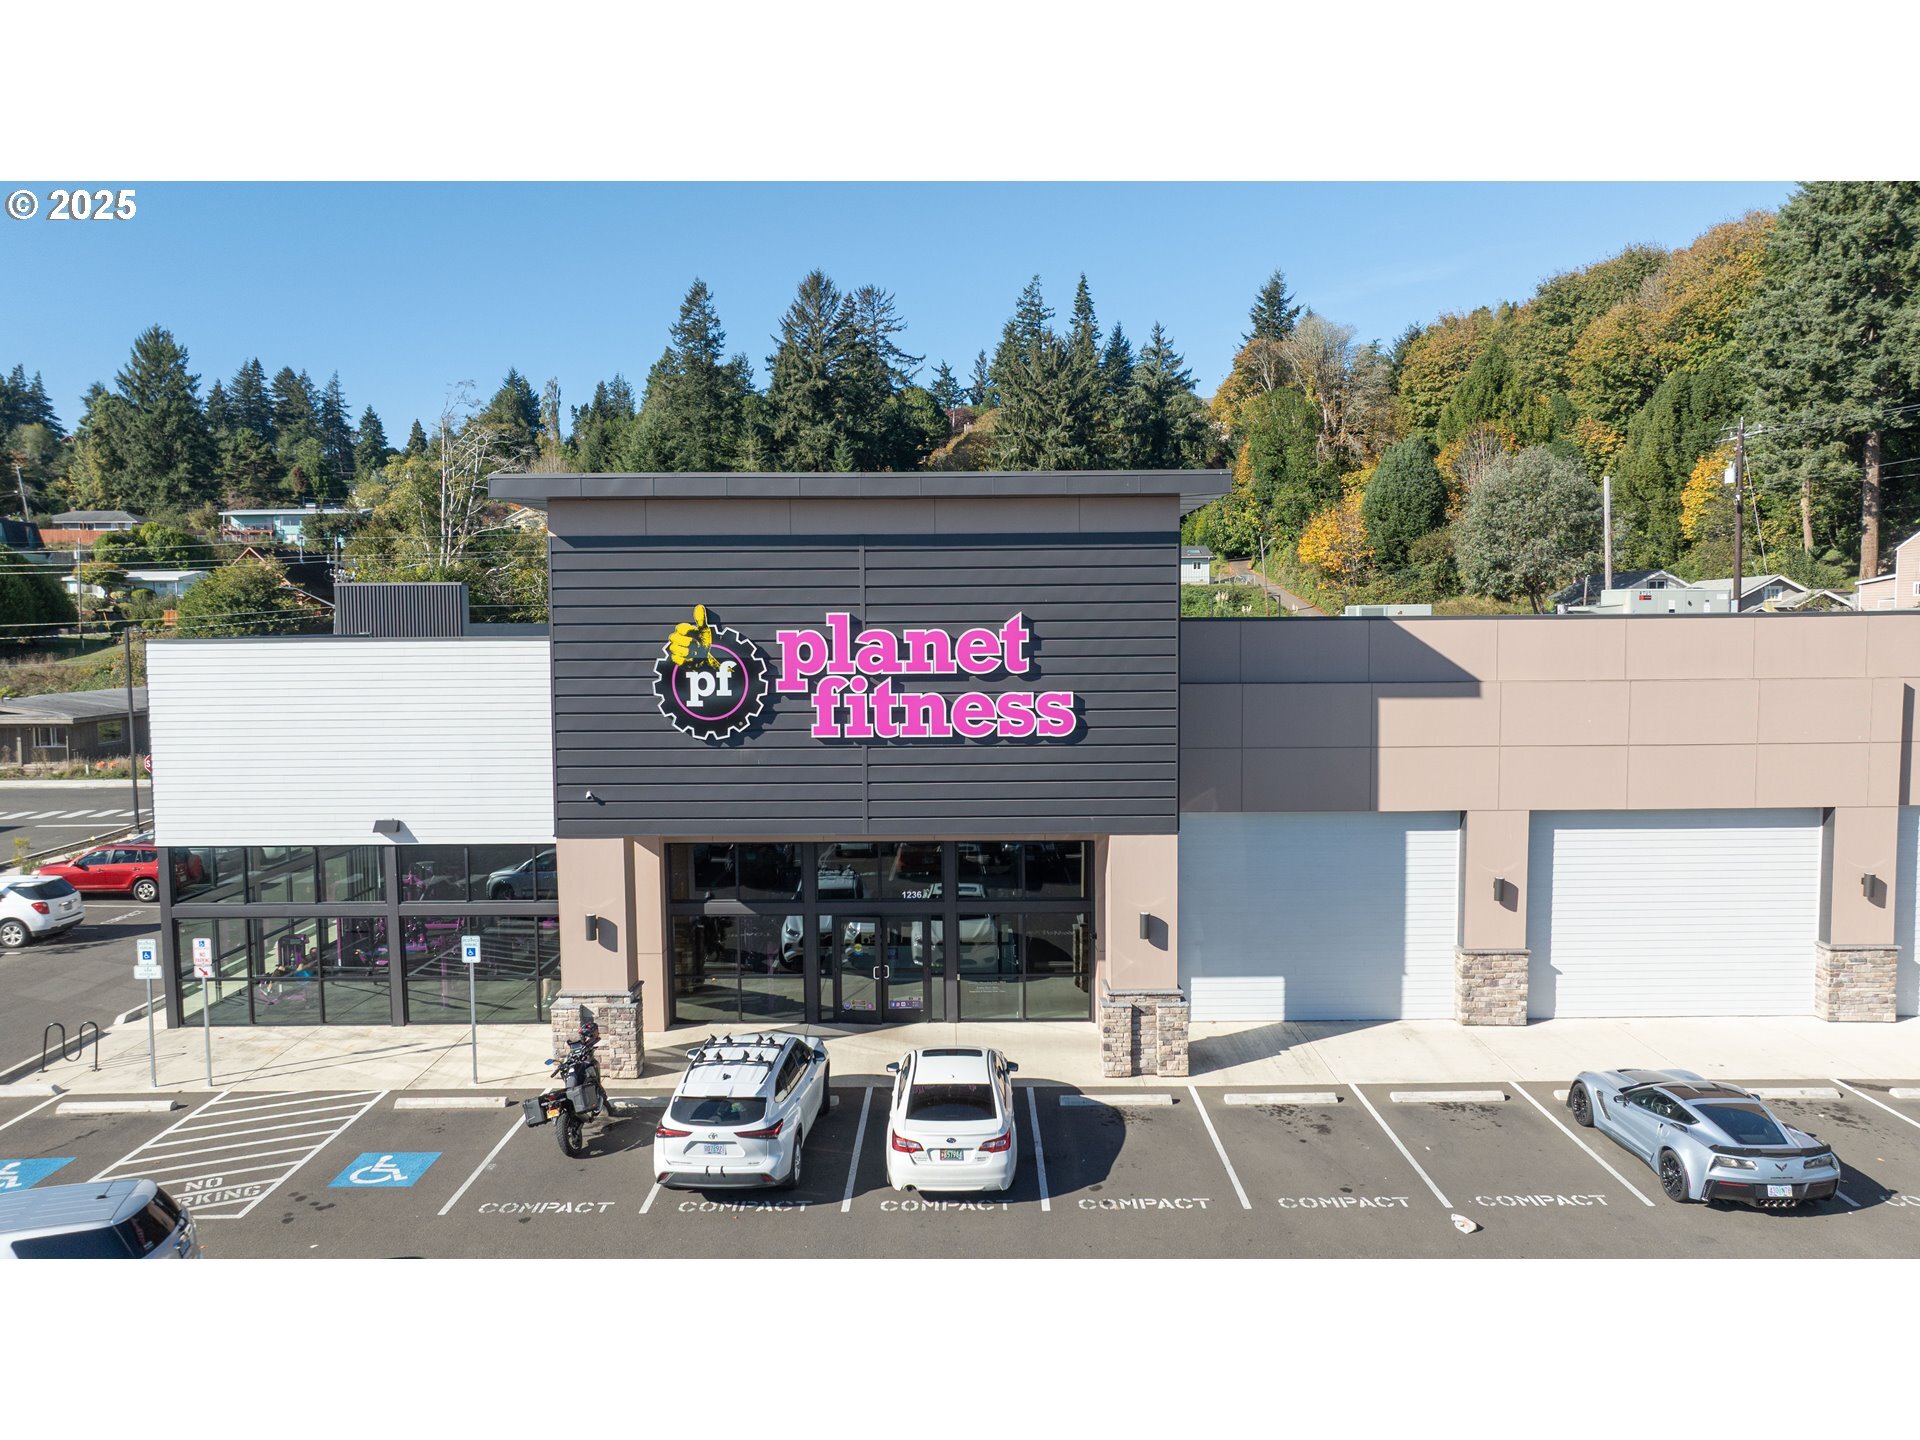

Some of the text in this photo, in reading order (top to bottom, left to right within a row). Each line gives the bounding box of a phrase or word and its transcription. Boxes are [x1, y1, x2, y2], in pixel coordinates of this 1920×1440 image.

[776, 611, 1029, 693] planet
[686, 660, 737, 706] pf
[811, 675, 1077, 738] fitness
[901, 890, 922, 899] 1236
[184, 1177, 223, 1192] NO
[477, 1201, 616, 1213] COMPACT
[678, 1200, 814, 1212] COMPACT
[879, 1199, 1014, 1211] COMPACT
[1078, 1197, 1211, 1210] COMPACT
[1278, 1195, 1409, 1208] COMPACT
[1476, 1194, 1609, 1207] COMPACT
